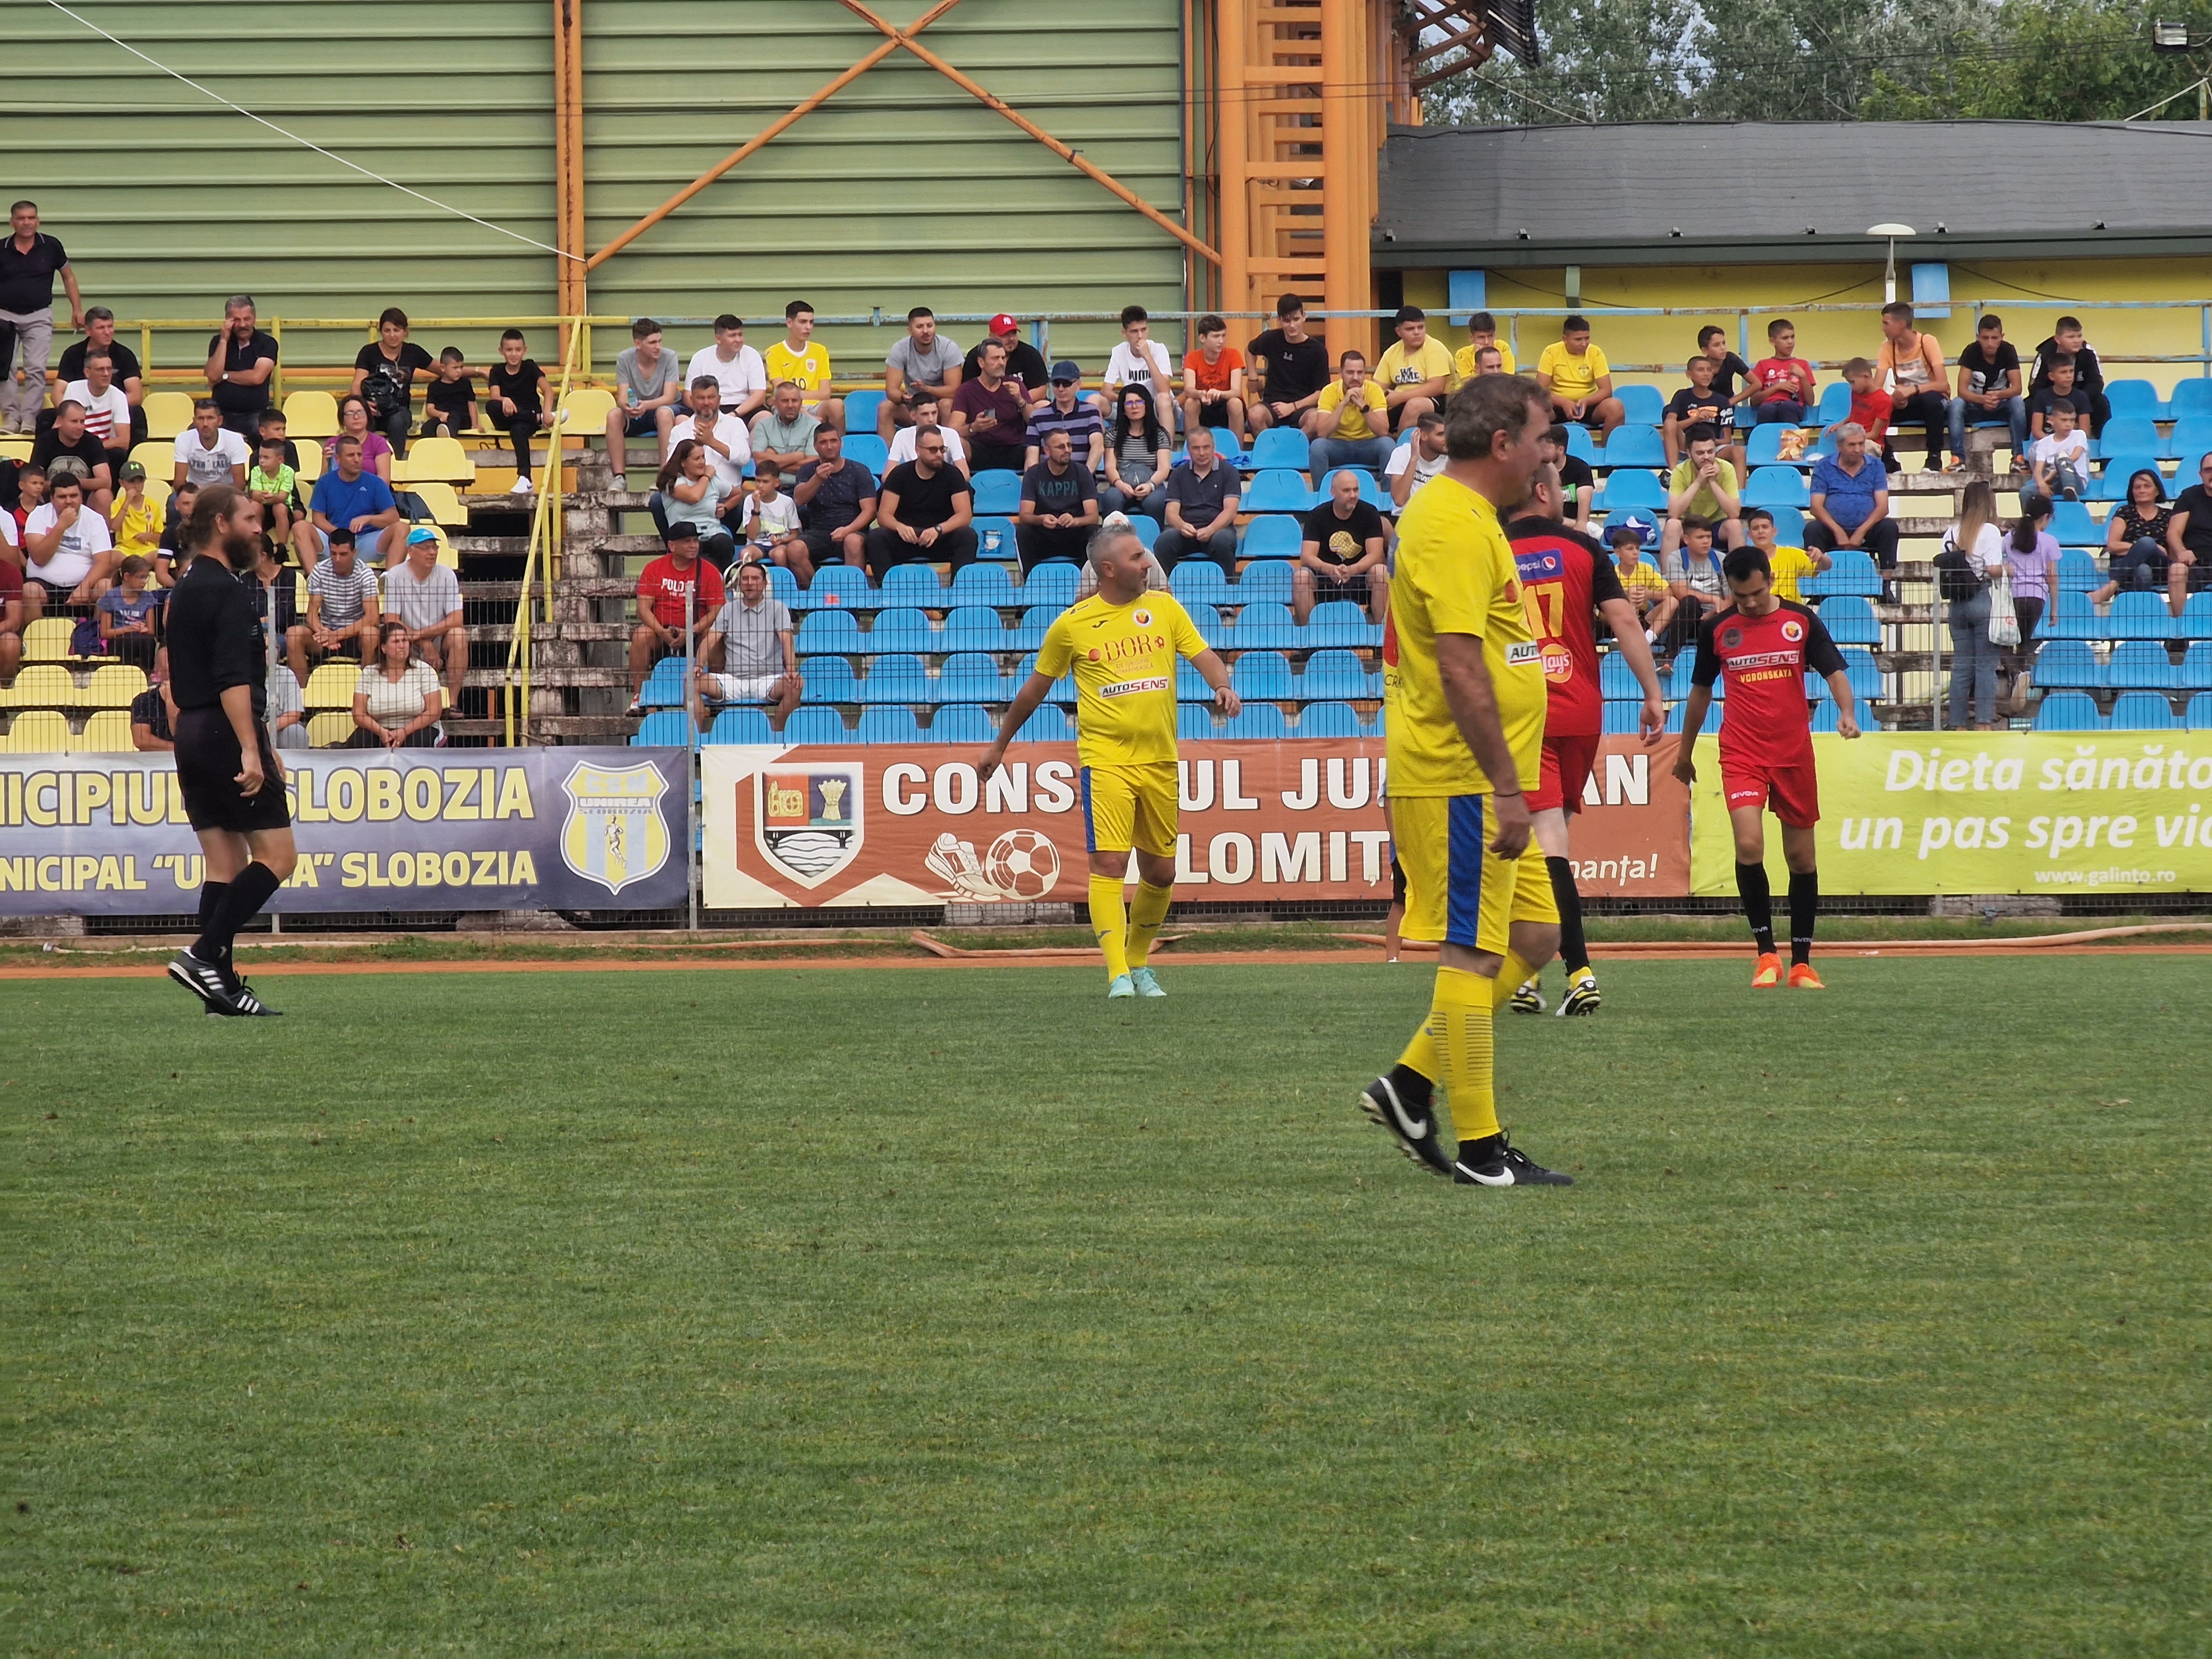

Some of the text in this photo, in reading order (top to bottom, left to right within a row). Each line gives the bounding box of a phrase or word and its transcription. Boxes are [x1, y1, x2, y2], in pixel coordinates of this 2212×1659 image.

[1038, 480, 1078, 497] KAPPA
[660, 578, 685, 592] POLO
[1524, 582, 1564, 640] 17
[1103, 634, 1153, 662] DOR
[1510, 645, 1537, 659] AUT
[1885, 748, 2023, 792] Dieta
[580, 797, 651, 807] UNIREA
[882, 759, 1259, 815] CONSUL
[1839, 817, 1903, 850] un
[1918, 816, 2011, 859] pas
[2025, 815, 2138, 859] spre
[341, 850, 538, 888] SLOBOZIA
[1124, 830, 1394, 888] LOMIȚ
[2034, 867, 2176, 886] www.galinto.ro
